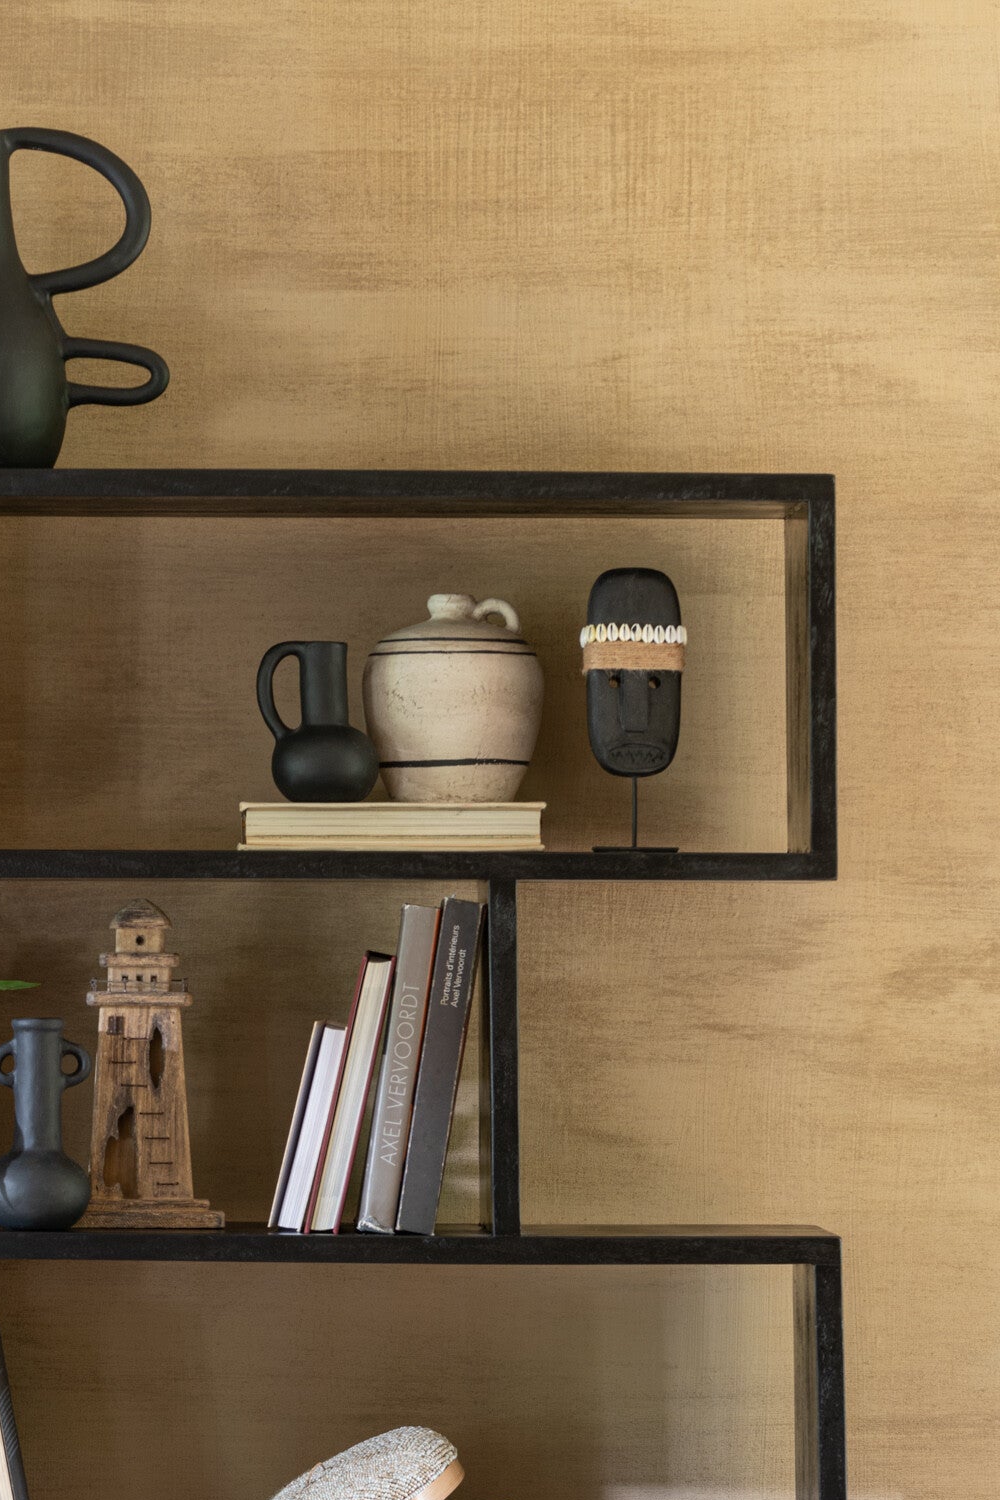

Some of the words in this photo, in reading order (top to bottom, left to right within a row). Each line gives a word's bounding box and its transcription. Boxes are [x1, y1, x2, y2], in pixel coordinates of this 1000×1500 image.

[454, 949, 467, 988] Vervoordt
[440, 972, 453, 1006] Portraits
[450, 989, 460, 1008] Axel
[386, 982, 420, 1109] VERVOORDT
[380, 1120, 402, 1167] AXEL
